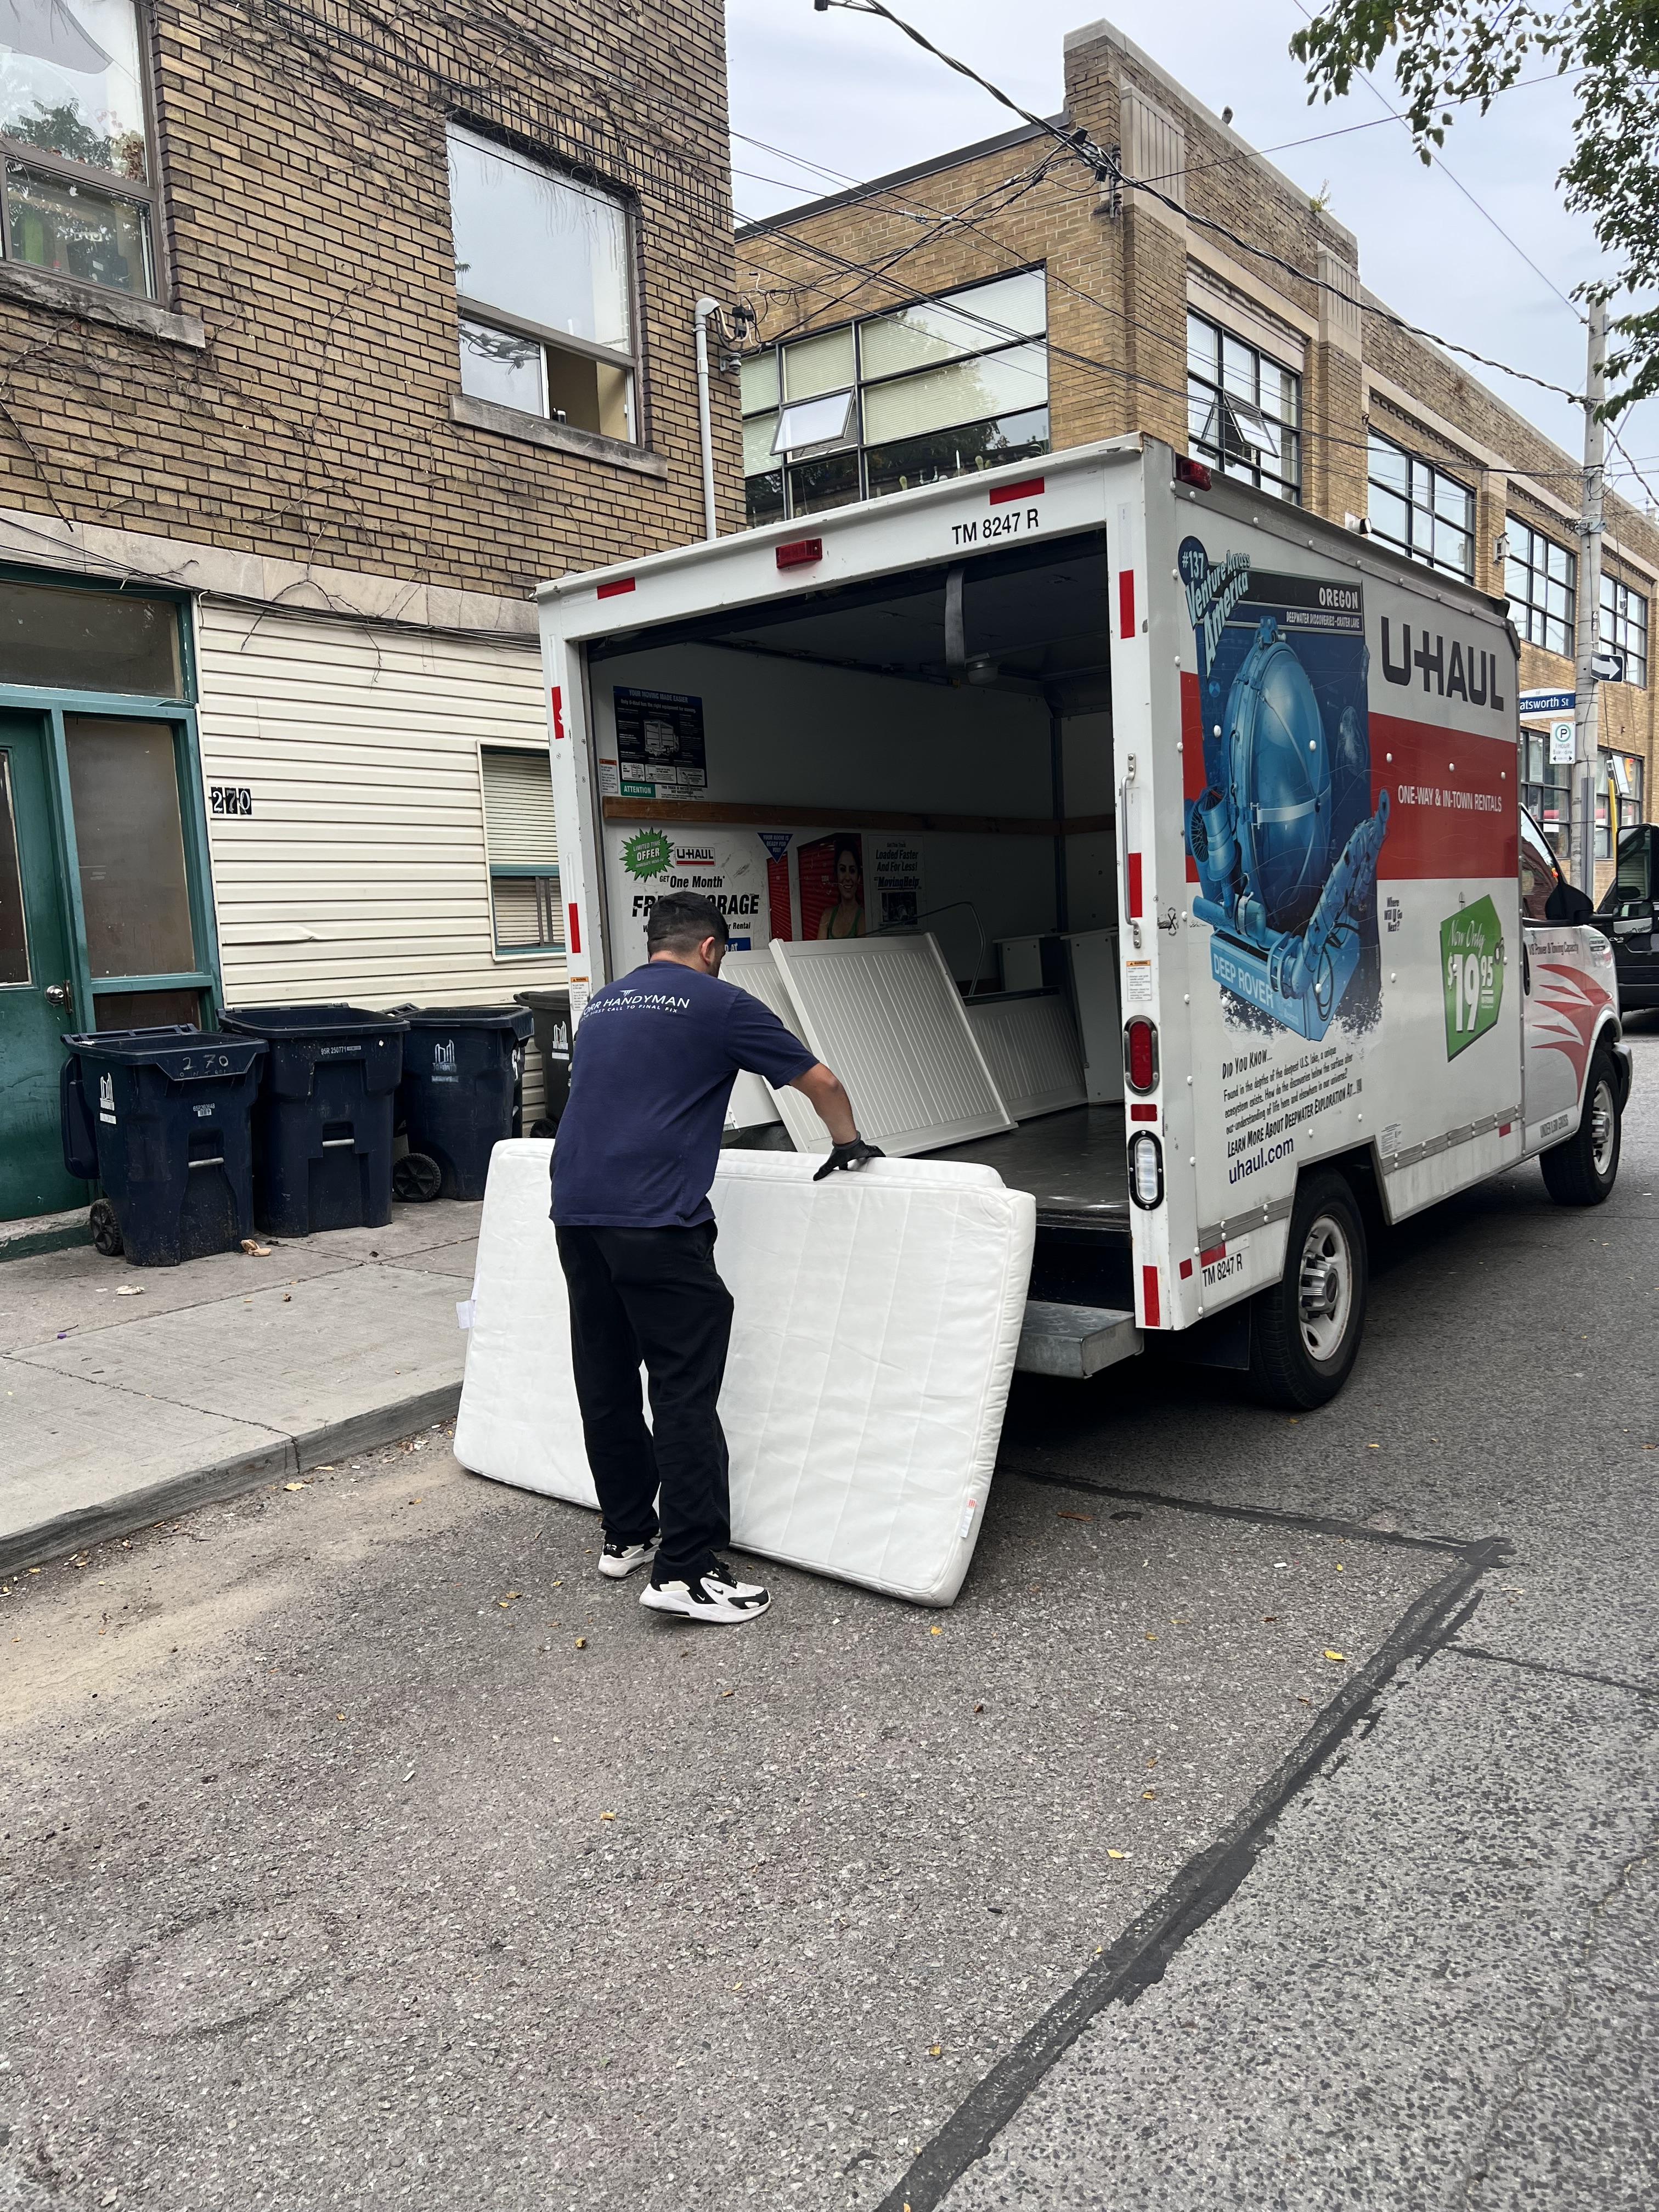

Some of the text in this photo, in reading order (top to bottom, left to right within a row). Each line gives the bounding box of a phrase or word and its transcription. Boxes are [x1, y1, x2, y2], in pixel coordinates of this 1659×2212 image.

[952, 508, 1039, 545] TM 8247 R
[1182, 550, 1205, 579] #137
[1185, 549, 1251, 630] Venture Across
[1319, 587, 1358, 609] OREGON
[1204, 571, 1249, 680] America
[1381, 616, 1504, 712] U-HAUL
[1561, 697, 1569, 707] St
[623, 786, 651, 794] ATTENTION
[1398, 785, 1502, 812] ONE-WAY & IN-TOWN RENTALS
[212, 789, 251, 814] 270
[633, 843, 650, 851] LIMITED
[637, 848, 660, 861] OFFER
[676, 849, 714, 859] U-HAUL
[876, 849, 918, 860] Loaded Faster
[877, 862, 917, 872] And For Less!
[670, 876, 689, 888] One
[878, 876, 920, 890] MovingHelp
[732, 922, 751, 930] Rental
[1448, 919, 1486, 958] Now Only
[1214, 953, 1273, 1008] DEEP ROVER
[603, 995, 690, 1008] HANDYMAN
[1222, 1062, 1233, 1079] DID
[1235, 1057, 1248, 1074] YOU
[1223, 1084, 1238, 1102] Found
[1240, 1084, 1244, 1095] in
[1254, 1073, 1268, 1090] depths
[1270, 1069, 1275, 1082] of
[1284, 1060, 1299, 1076] deepest
[1225, 1102, 1248, 1119] ecosystem
[1265, 1087, 1274, 1100] How
[1276, 1084, 1281, 1094] do
[1290, 1072, 1310, 1088] discoveries
[1267, 1103, 1271, 1115] of
[1280, 1098, 1290, 1109] here
[1229, 1138, 1294, 1184] uhaul.com
[1202, 1253, 1243, 1287] TM 8247 R
